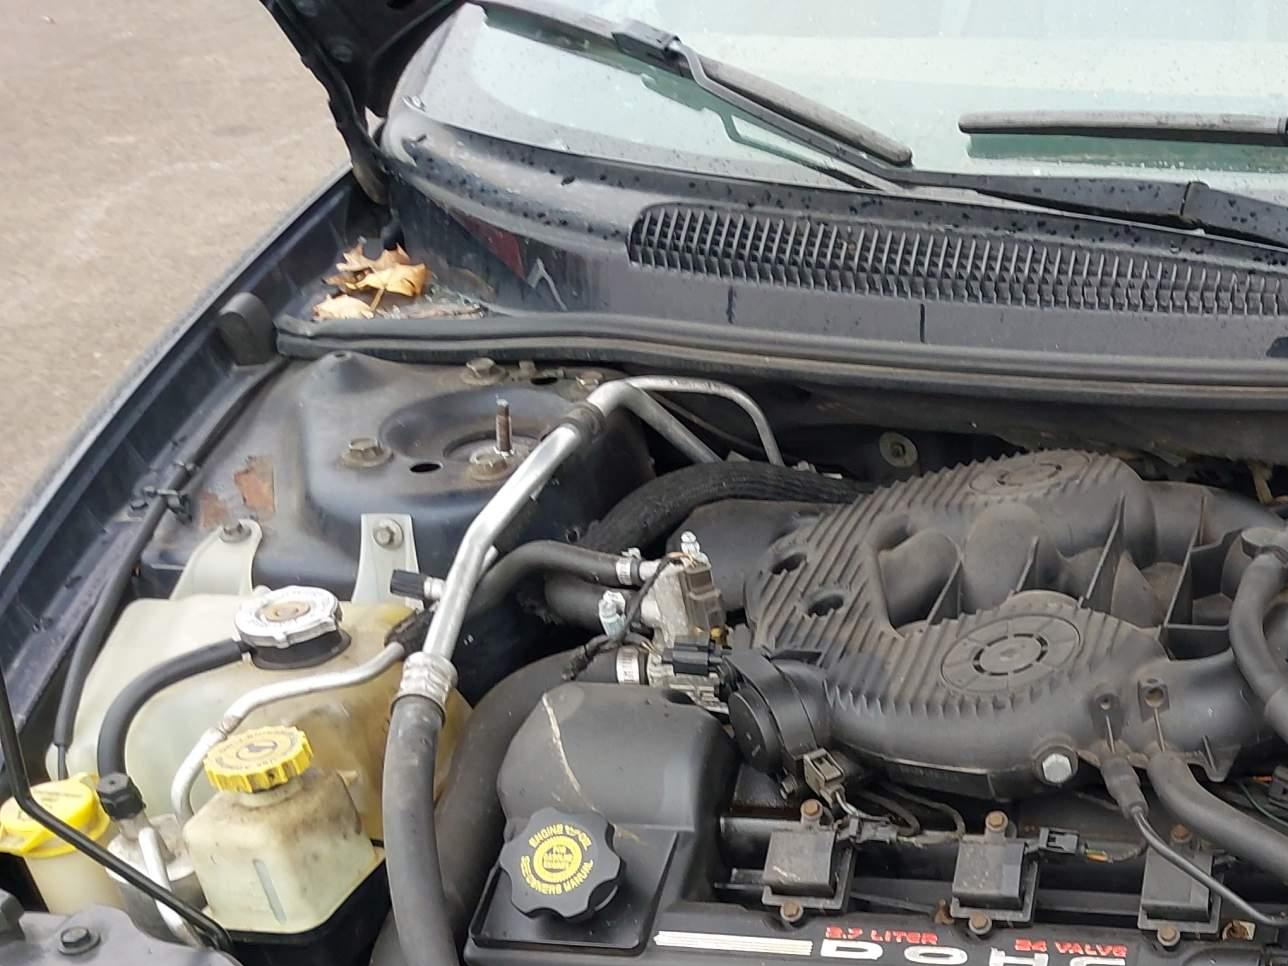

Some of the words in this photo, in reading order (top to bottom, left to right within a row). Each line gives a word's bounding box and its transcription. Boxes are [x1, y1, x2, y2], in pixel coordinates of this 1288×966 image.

[563, 859, 593, 892] MANUAL
[825, 926, 863, 941] 2.7
[871, 929, 938, 945] LITER
[1014, 938, 1048, 953] 24
[1055, 940, 1128, 958] VALVE
